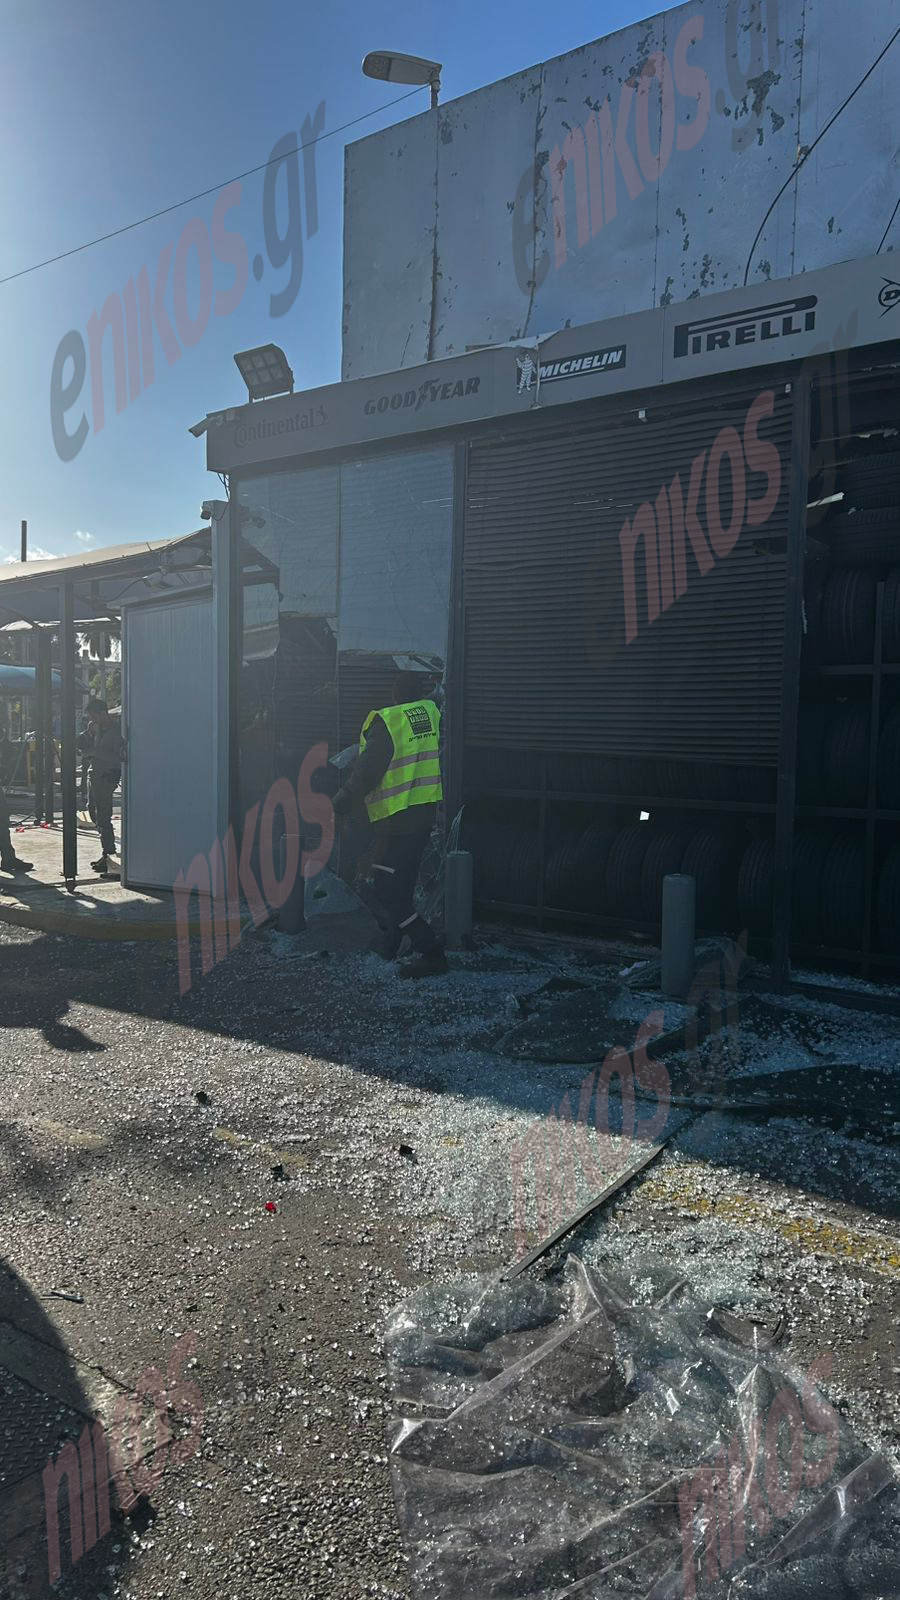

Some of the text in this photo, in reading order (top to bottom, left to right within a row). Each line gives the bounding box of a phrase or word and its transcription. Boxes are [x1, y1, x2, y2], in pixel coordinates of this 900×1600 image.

[673, 295, 818, 358] PIRELLI
[538, 350, 623, 379] MICHELIN
[233, 407, 315, 449] Continental
